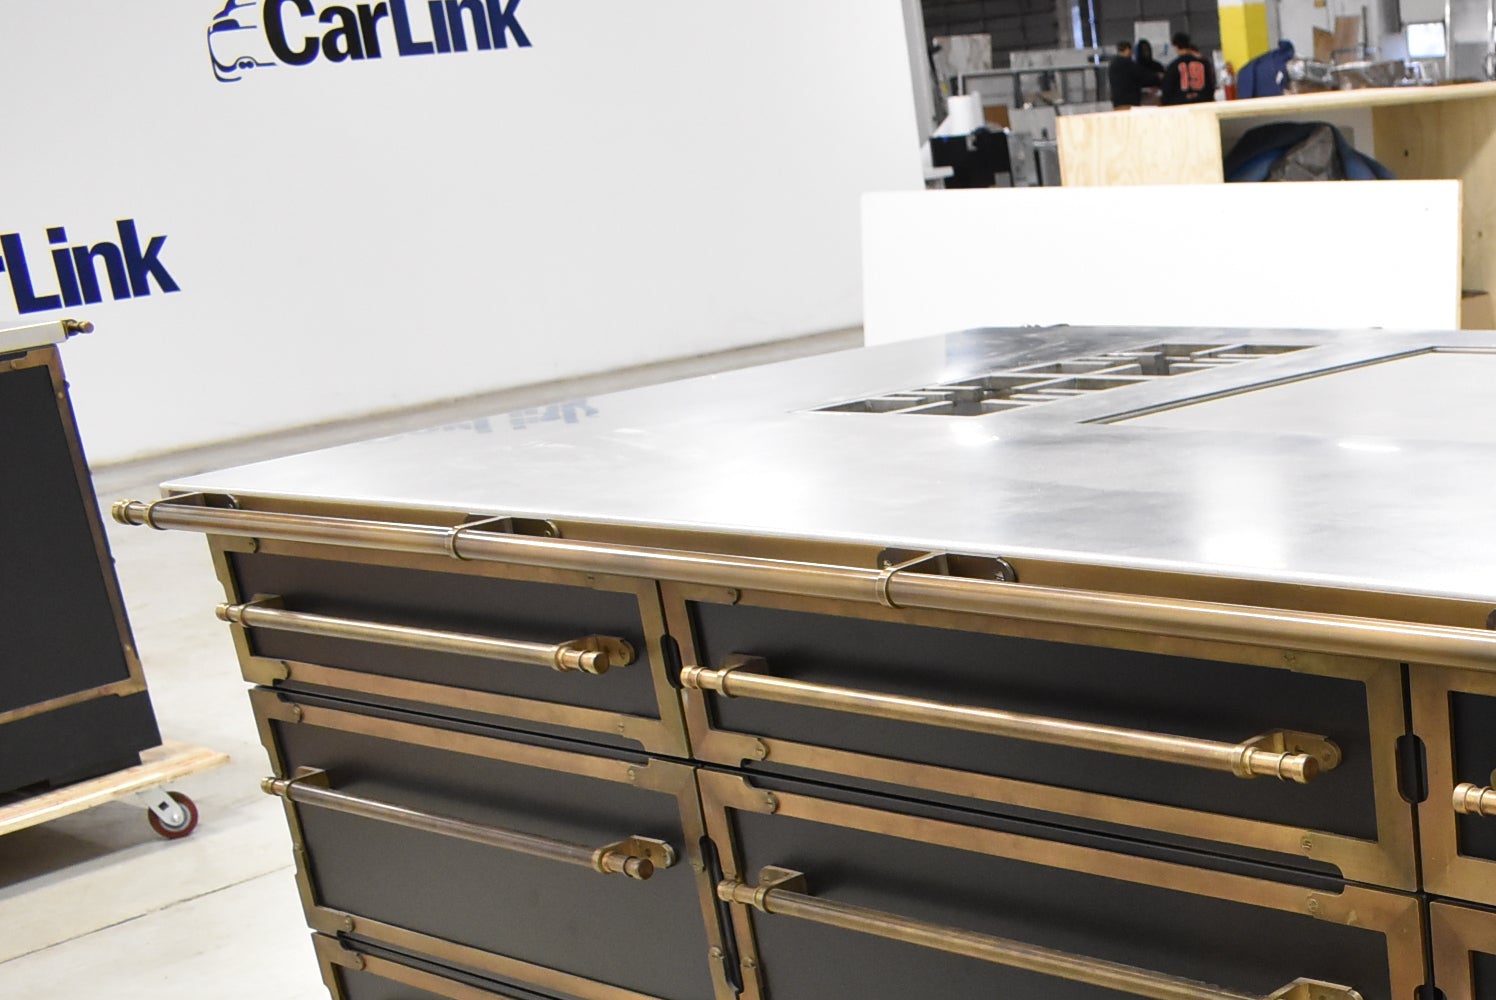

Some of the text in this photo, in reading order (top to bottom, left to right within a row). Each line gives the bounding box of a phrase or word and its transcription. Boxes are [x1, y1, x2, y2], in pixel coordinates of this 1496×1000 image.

[263, 0, 532, 66] CarLink
[1178, 61, 1205, 90] 19
[0, 219, 181, 314] Link
